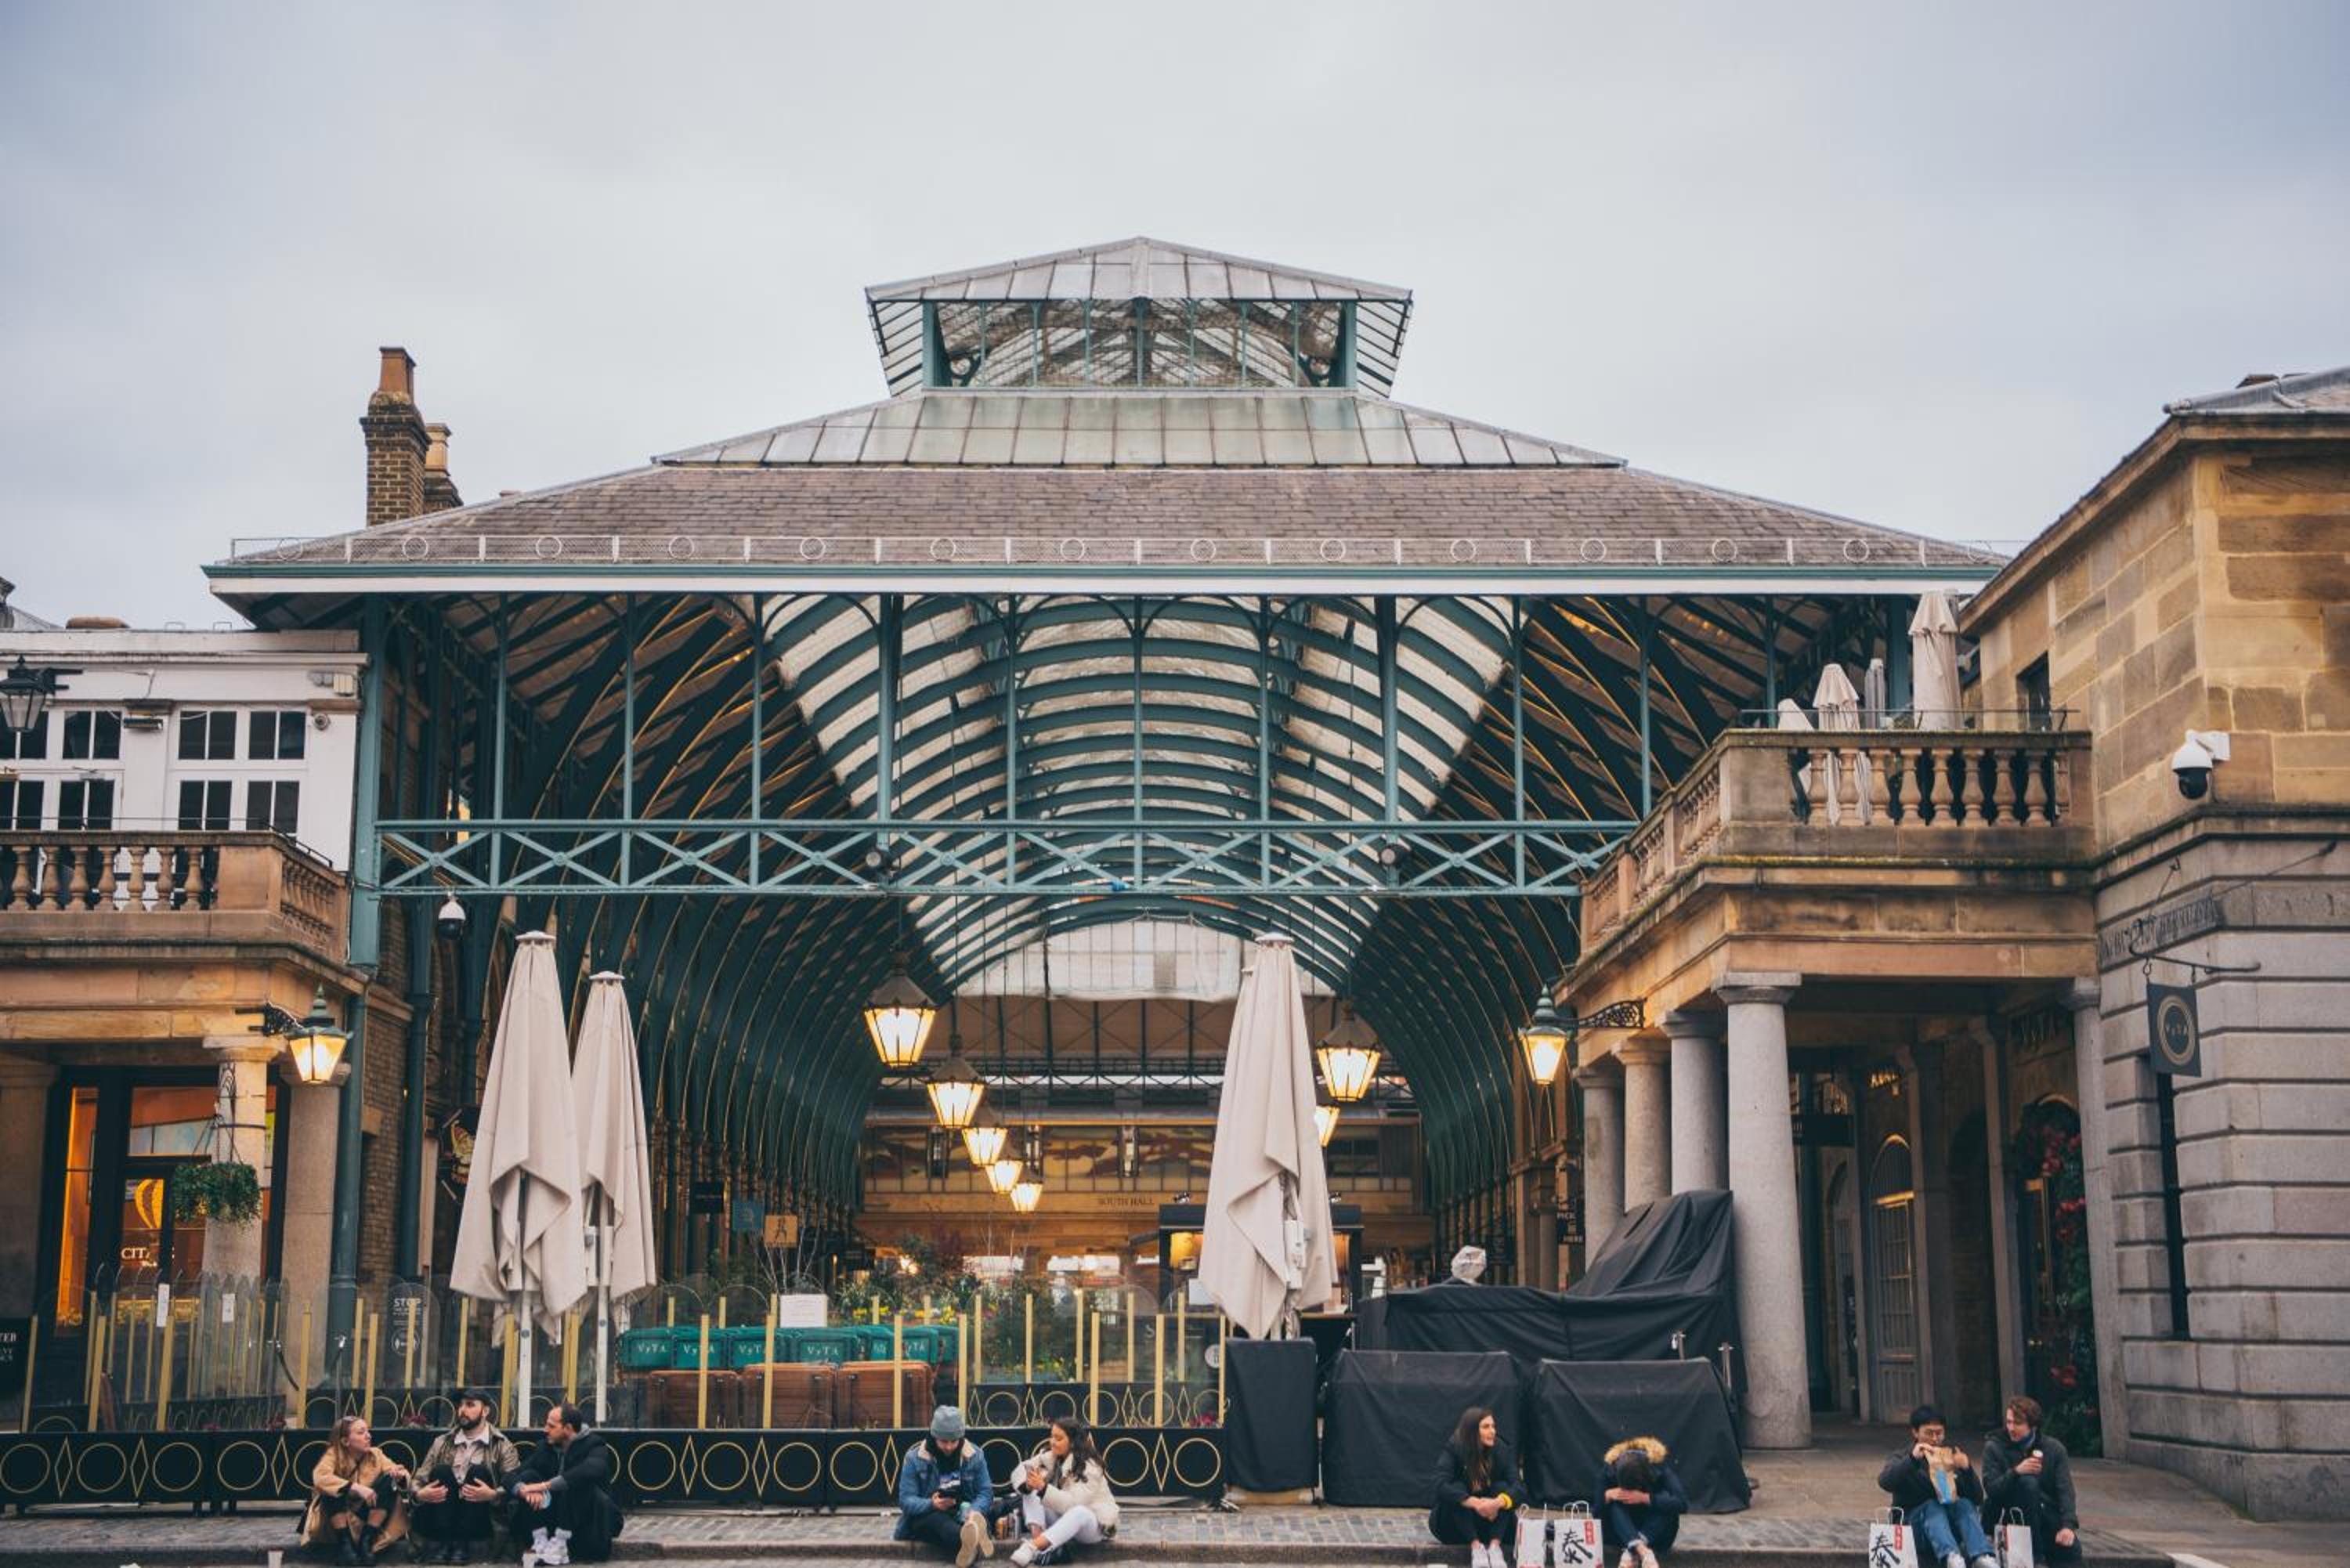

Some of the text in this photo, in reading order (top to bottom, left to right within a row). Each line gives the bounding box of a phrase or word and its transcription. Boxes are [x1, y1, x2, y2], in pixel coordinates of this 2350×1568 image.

[1098, 1195, 1155, 1206] SOUTH HALL
[683, 1343, 715, 1357] VyA
[739, 1343, 766, 1356] VyT
